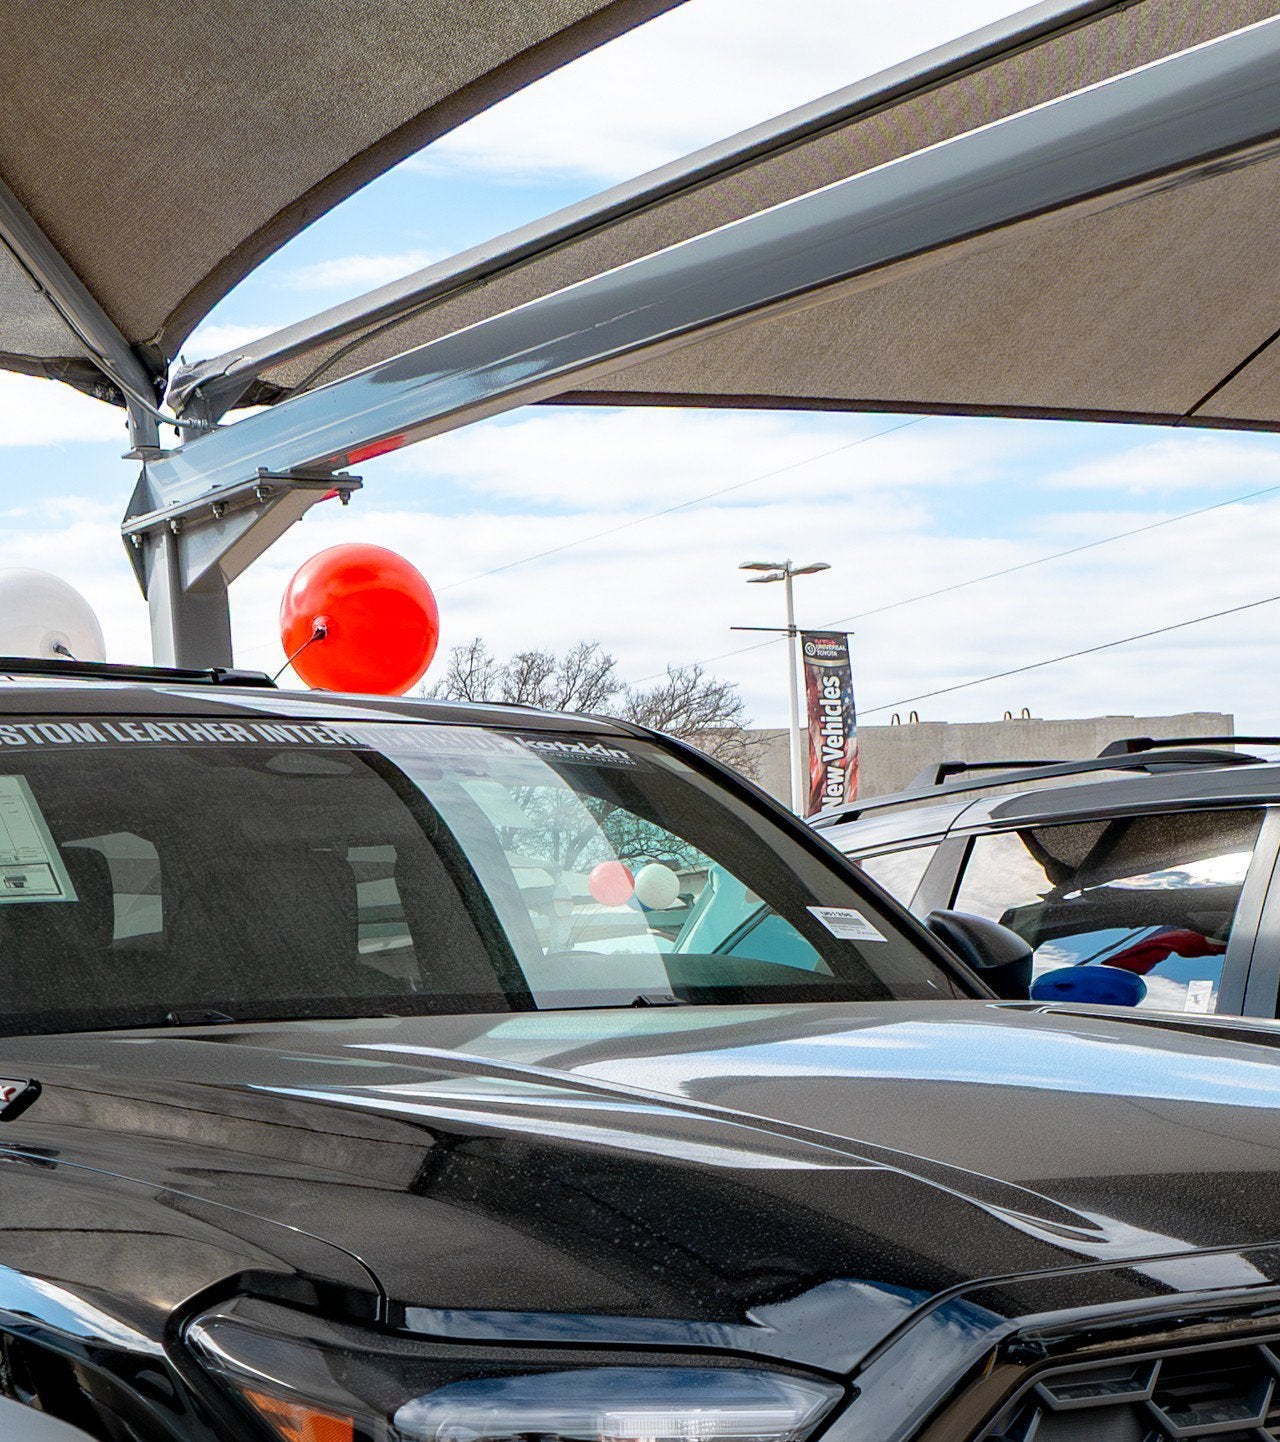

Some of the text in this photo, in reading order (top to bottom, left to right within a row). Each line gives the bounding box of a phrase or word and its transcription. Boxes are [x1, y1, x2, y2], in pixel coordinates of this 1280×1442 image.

[820, 675, 844, 763] Vehicles
[108, 722, 257, 745] LEATHER
[513, 736, 631, 760] katzkin
